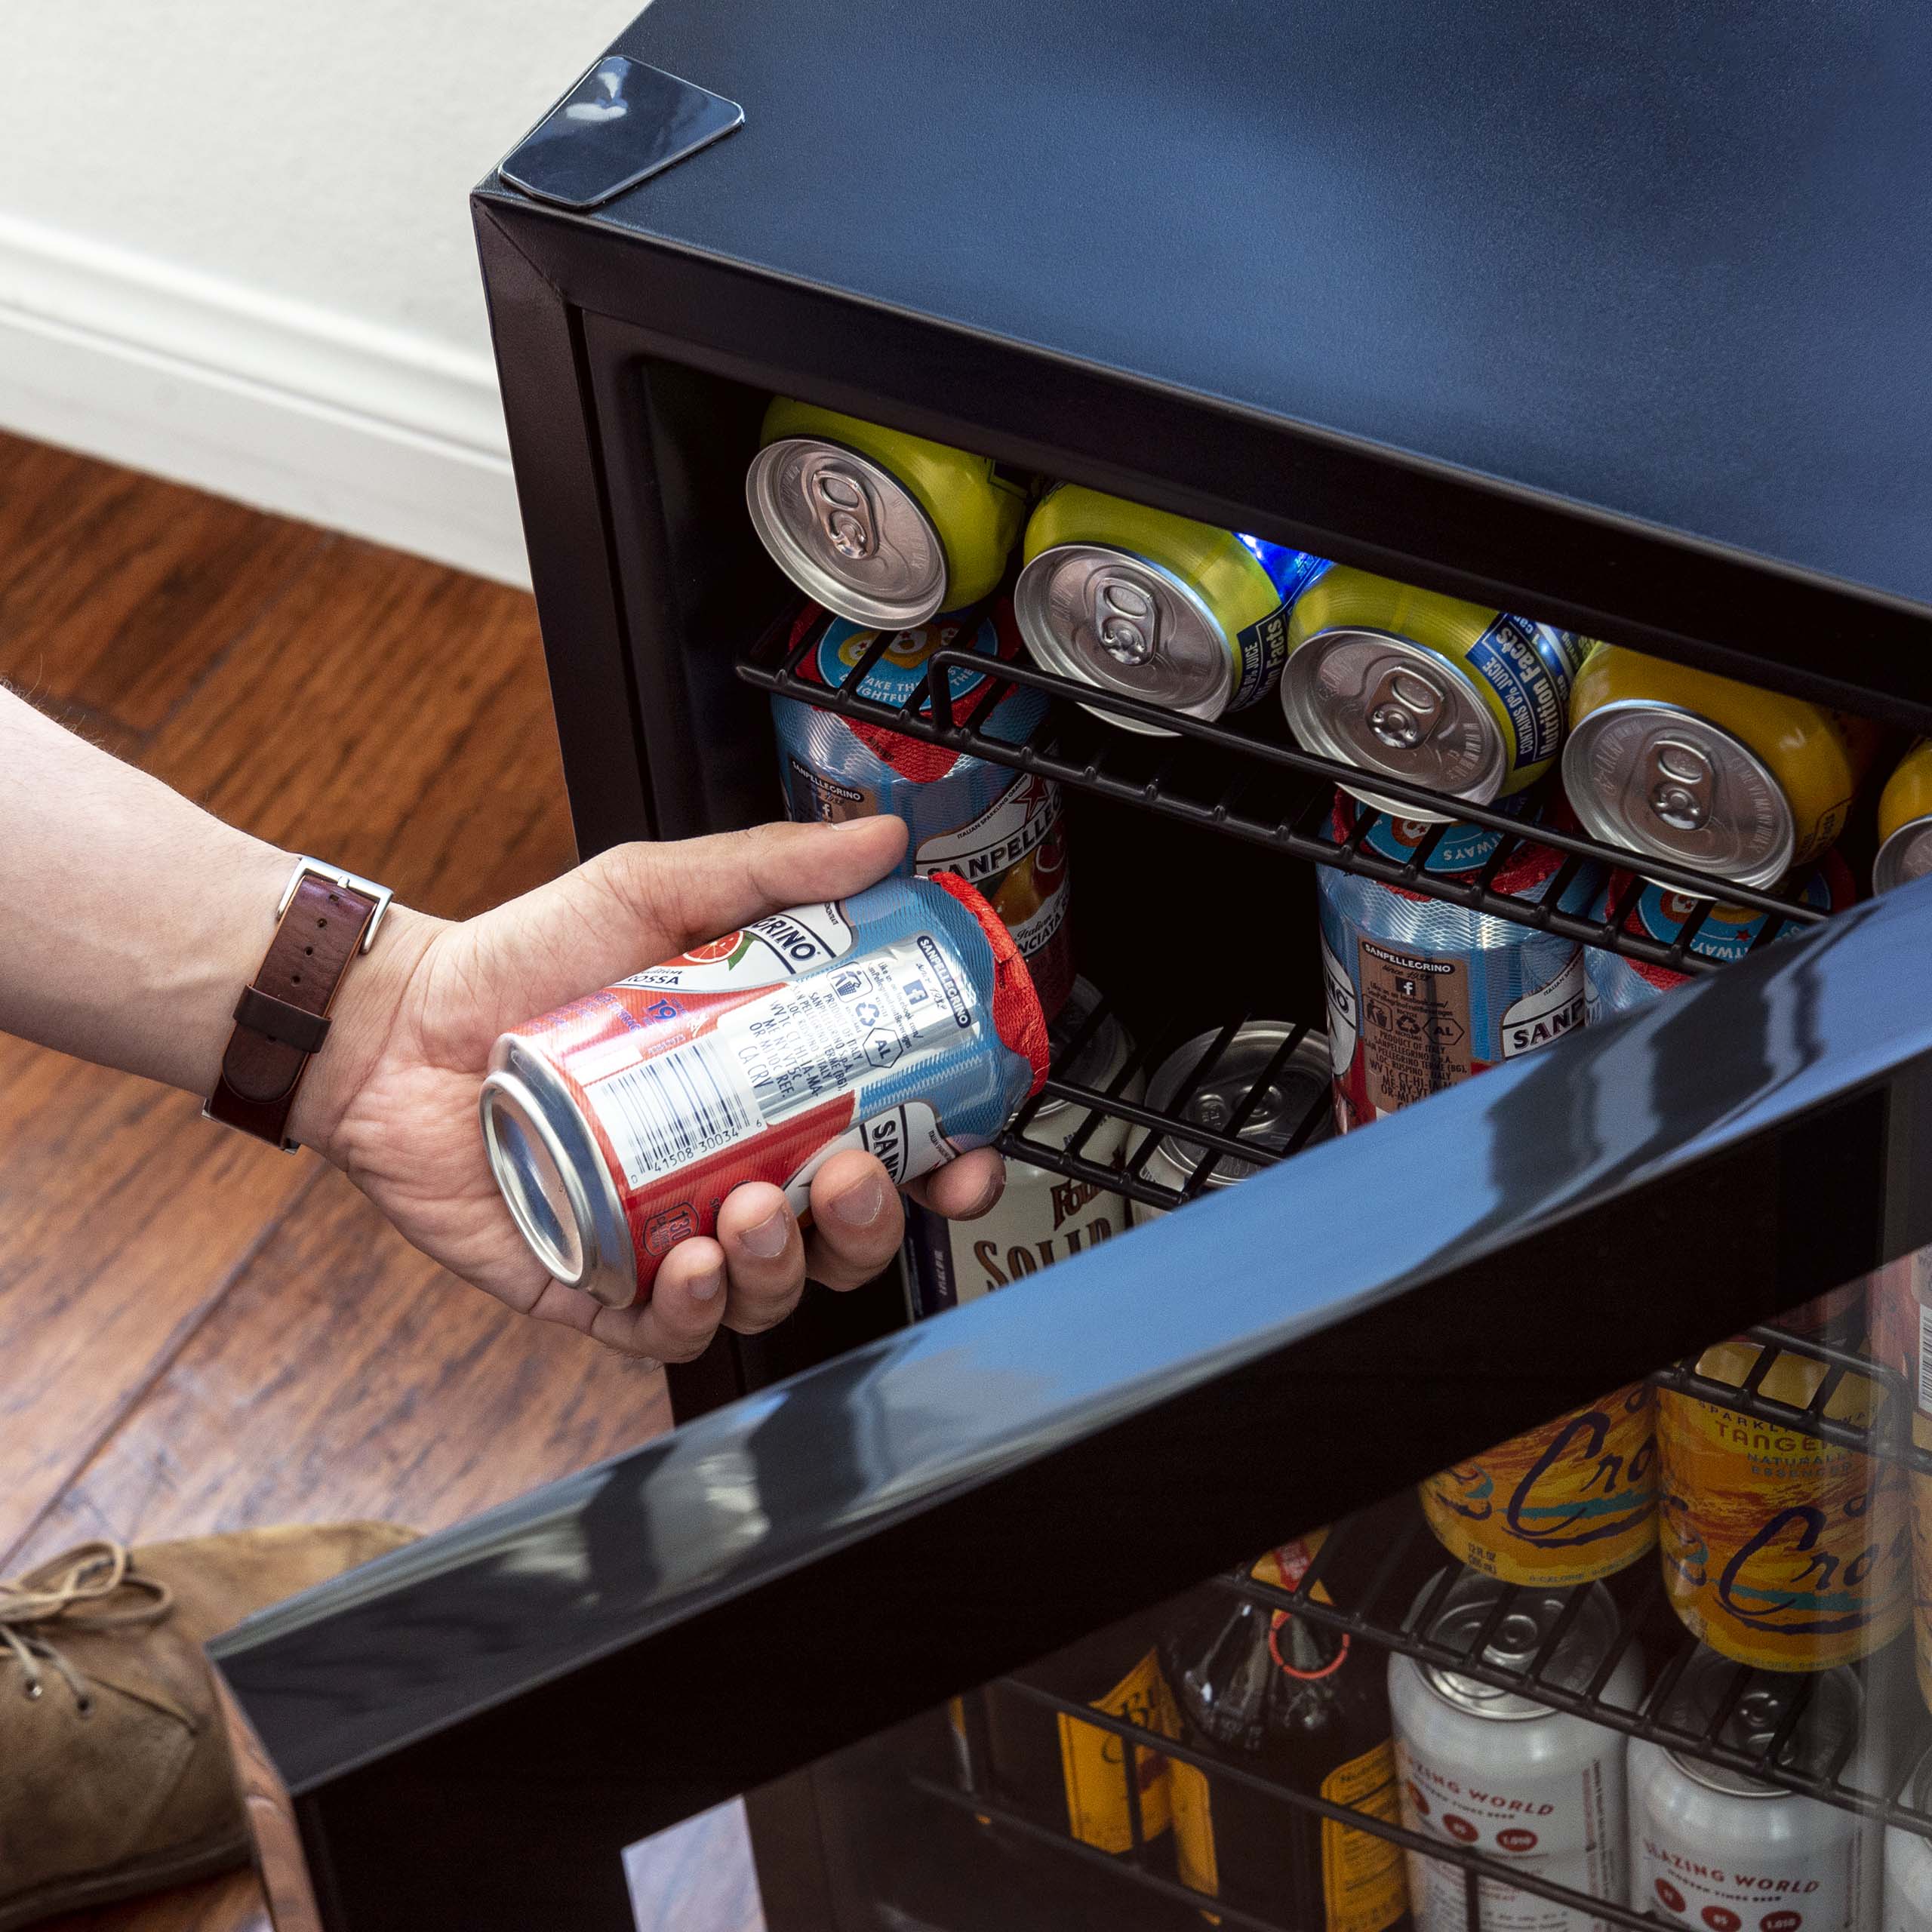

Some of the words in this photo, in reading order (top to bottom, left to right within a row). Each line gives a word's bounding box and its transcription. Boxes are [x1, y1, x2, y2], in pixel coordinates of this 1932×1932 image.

[1244, 641, 1260, 670] JUICE
[1266, 618, 1284, 669] Facts
[1495, 627, 1541, 683] Facts
[1482, 657, 1514, 691] JUICE
[1505, 687, 1523, 709] 0%
[1513, 706, 1535, 755] CONTAINS
[1533, 677, 1559, 755] Nutrition
[792, 760, 861, 801] SANPELLEGRINO
[957, 823, 980, 839] ITALIAN
[980, 797, 1009, 829] SPARKLING
[1443, 832, 1505, 861] TWAYS
[1015, 912, 1052, 941] Italian
[1364, 943, 1451, 973] SANPELLEGRINO
[918, 938, 969, 1025] SANPELLEGRINO
[1544, 978, 1564, 996] ITALIAN
[647, 998, 677, 1020] 19
[1380, 1030, 1412, 1047] PRODUCT
[1413, 1041, 1423, 1051] OF
[1435, 1026, 1454, 1036] AL
[737, 1044, 761, 1066] CA
[845, 1038, 863, 1061] ITALY
[875, 1038, 891, 1060] AL
[1374, 1036, 1429, 1060] SANPELLEGRINO
[1378, 1046, 1419, 1069] PELLEGRINO
[1447, 1064, 1468, 1074] (BG),
[745, 1062, 774, 1091] CRV
[815, 1057, 832, 1081] ITALY
[821, 1044, 841, 1070] TERME
[831, 1069, 850, 1091] (BG),
[1392, 1061, 1423, 1076] RUSPINO
[774, 1073, 795, 1098] REF.
[630, 1174, 638, 1184] 0
[654, 1146, 694, 1172] 41508
[698, 1128, 739, 1153] 30034
[755, 1119, 763, 1128] 6
[668, 1210, 692, 1241] 130
[1469, 1788, 1555, 1816] WORLD
[1734, 1873, 1820, 1893] WORLD
